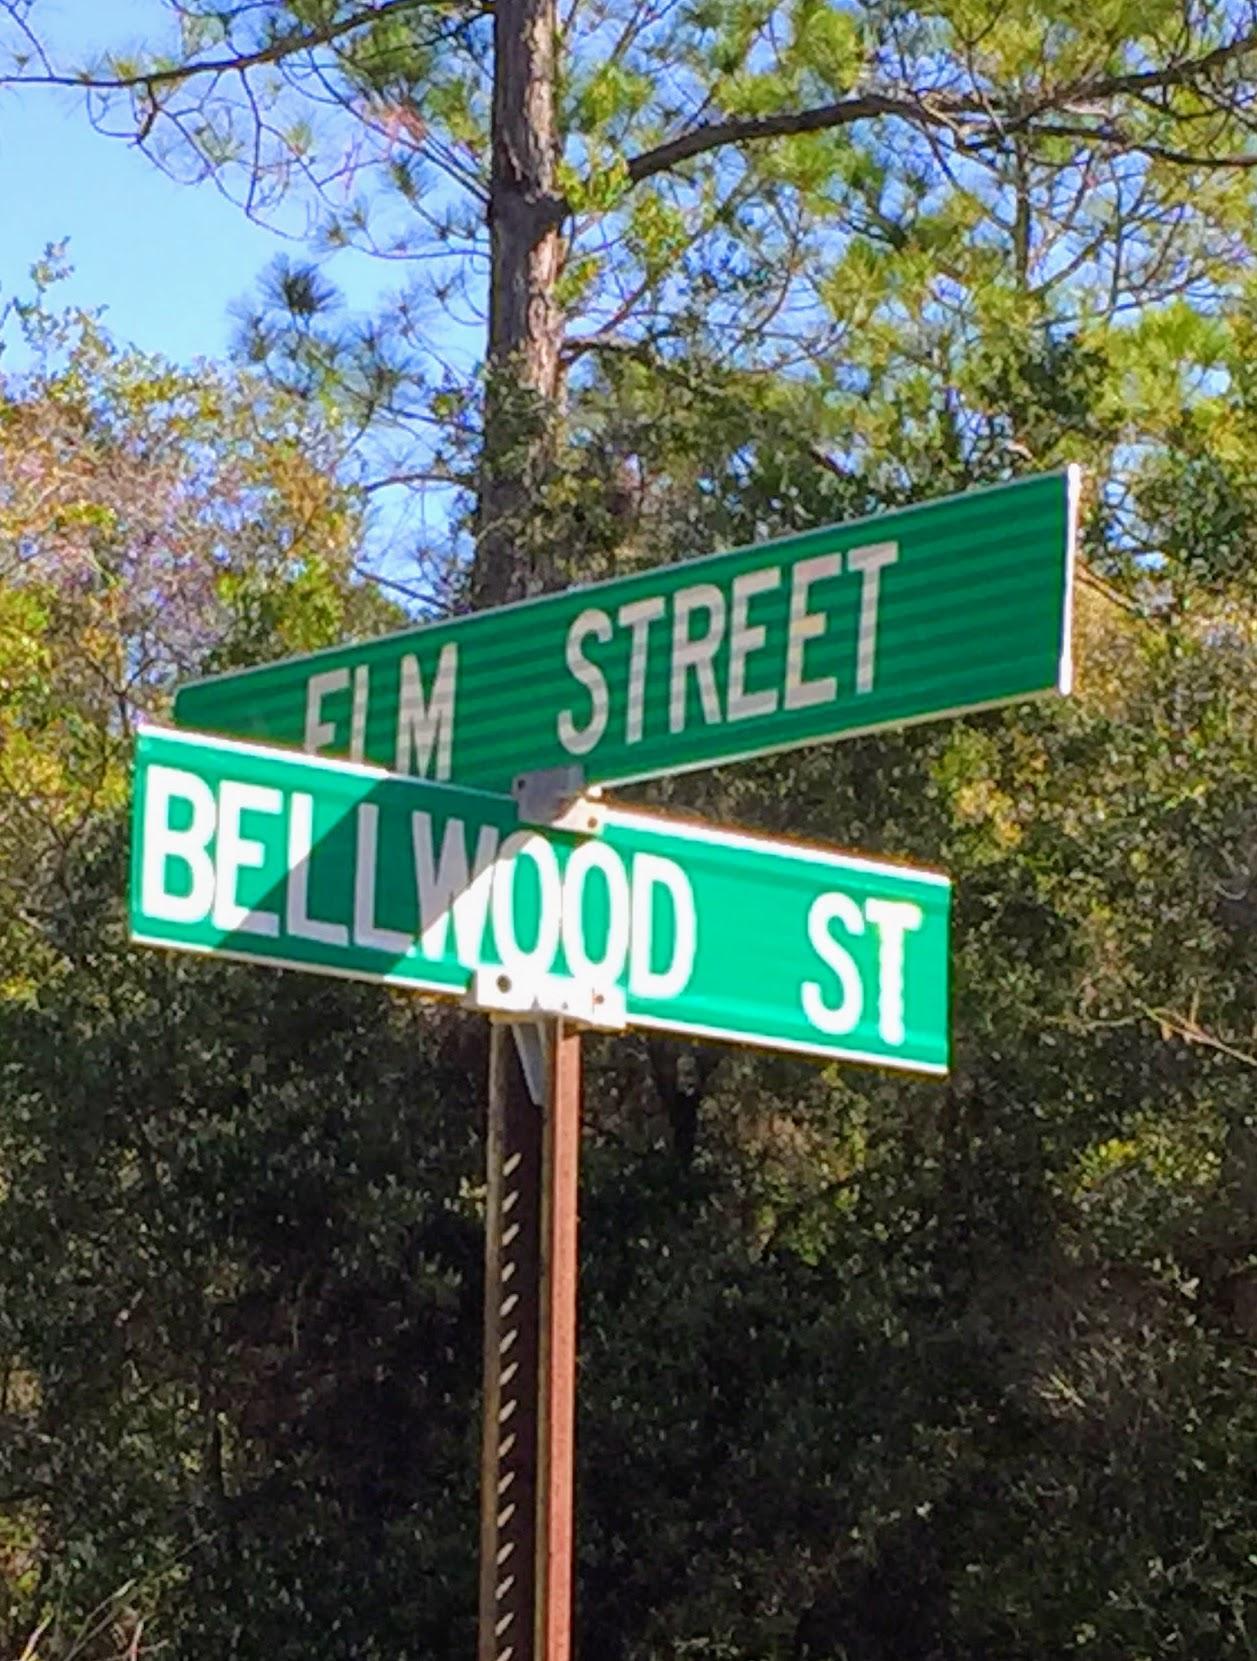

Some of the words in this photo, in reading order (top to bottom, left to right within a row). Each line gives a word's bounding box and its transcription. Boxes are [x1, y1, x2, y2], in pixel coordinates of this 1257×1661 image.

[557, 541, 899, 755] STREET
[141, 765, 697, 1000] BELLWOOD
[801, 892, 922, 1045] ST
